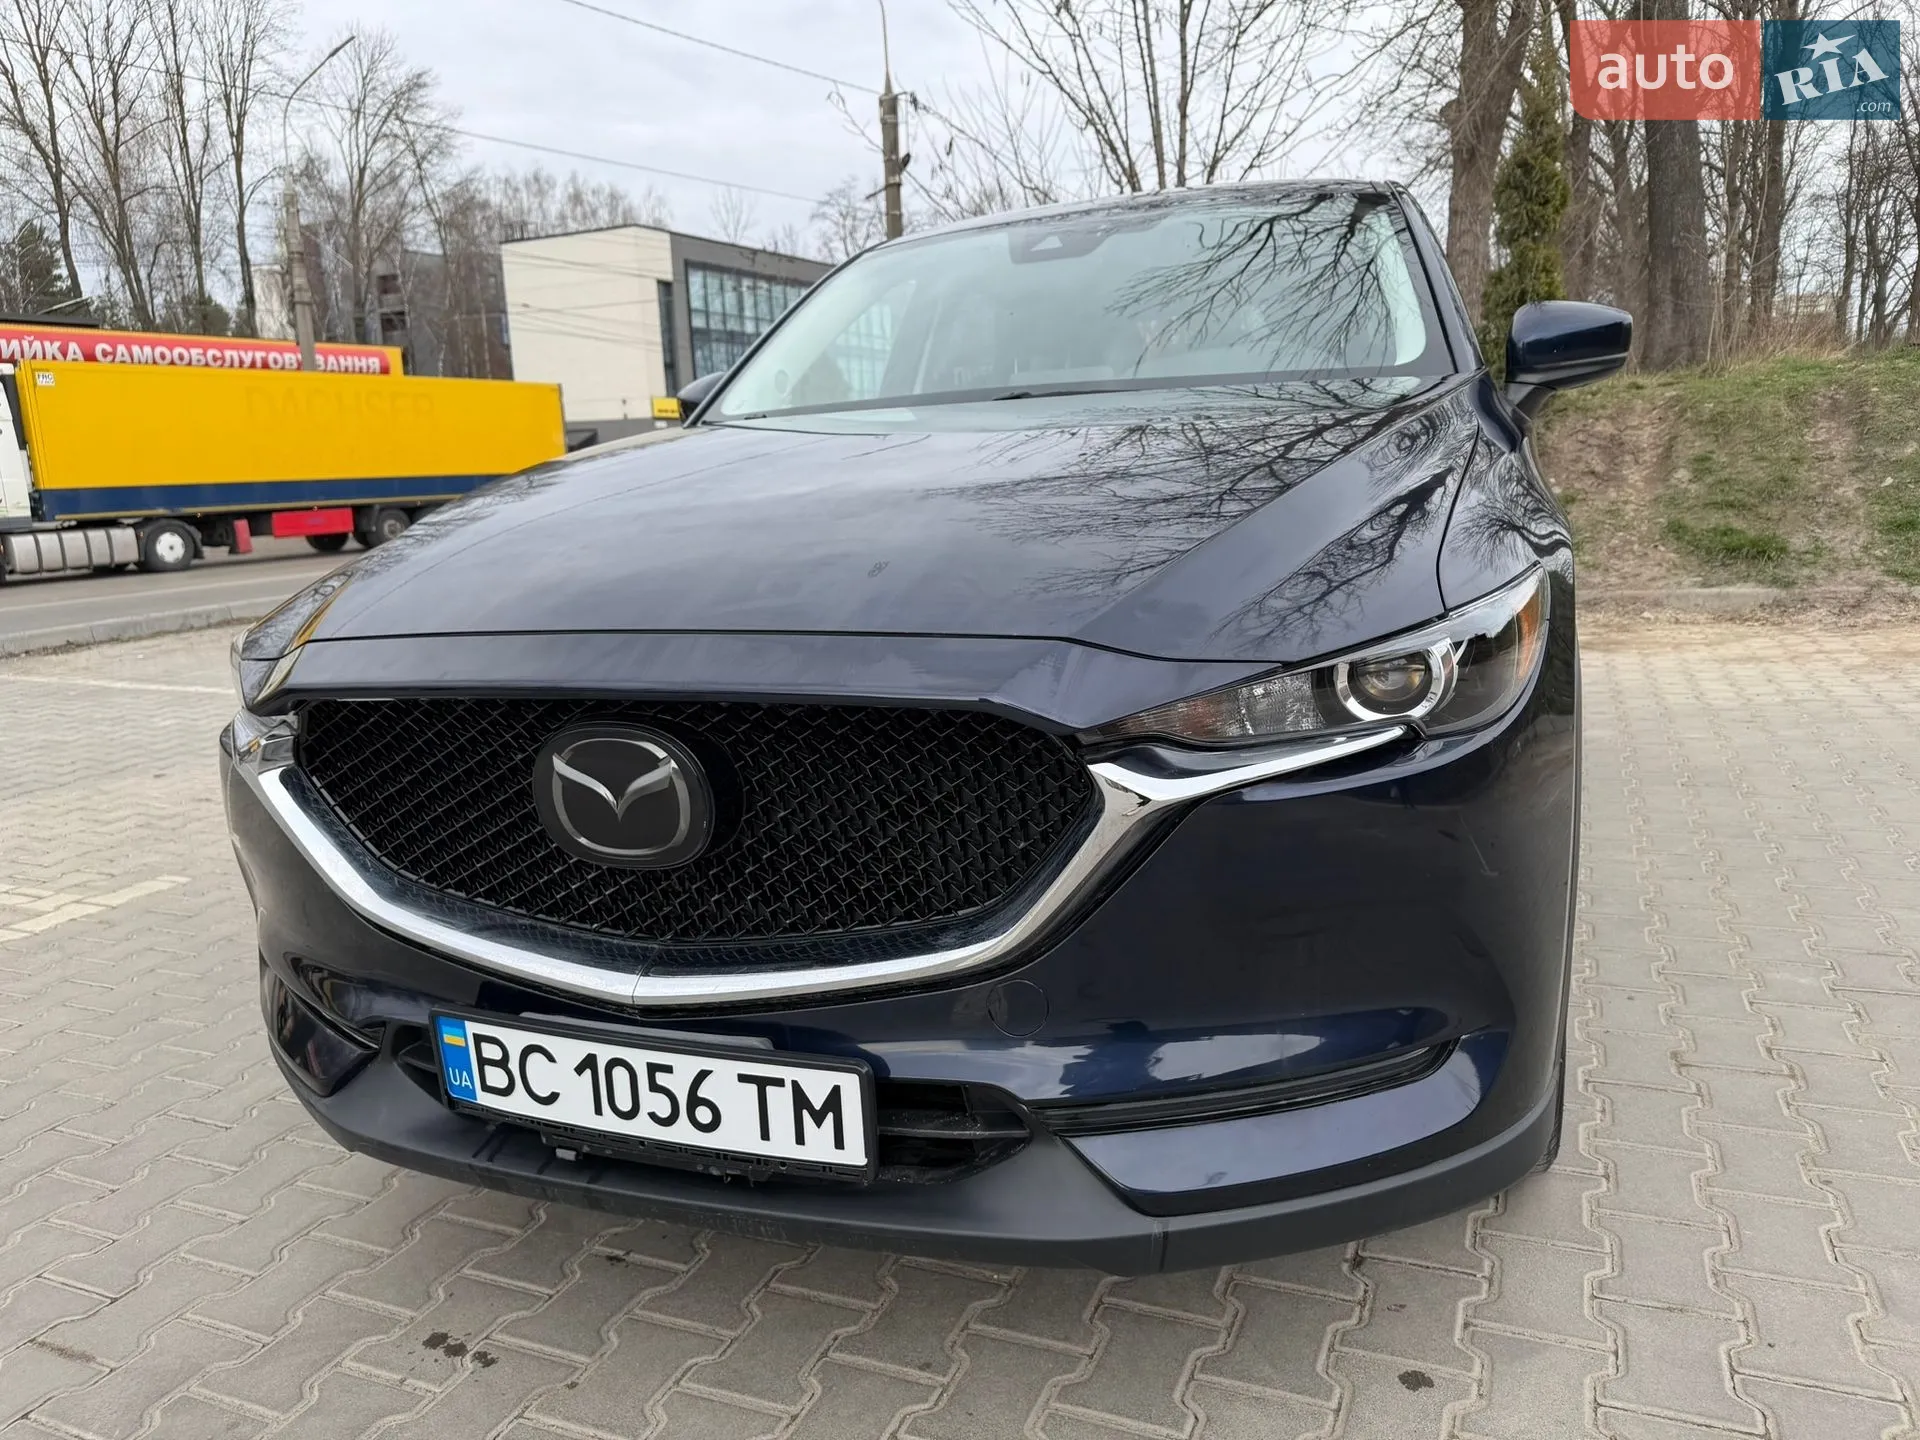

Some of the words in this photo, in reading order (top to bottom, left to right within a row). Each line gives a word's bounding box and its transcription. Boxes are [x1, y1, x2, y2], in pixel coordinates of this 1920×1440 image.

[95, 343, 381, 373] САМООБСЛУГОВВАННЯ
[449, 1067, 473, 1090] UA
[472, 1032, 561, 1106] BC
[573, 1053, 723, 1134] 1056
[737, 1073, 846, 1151] TM
